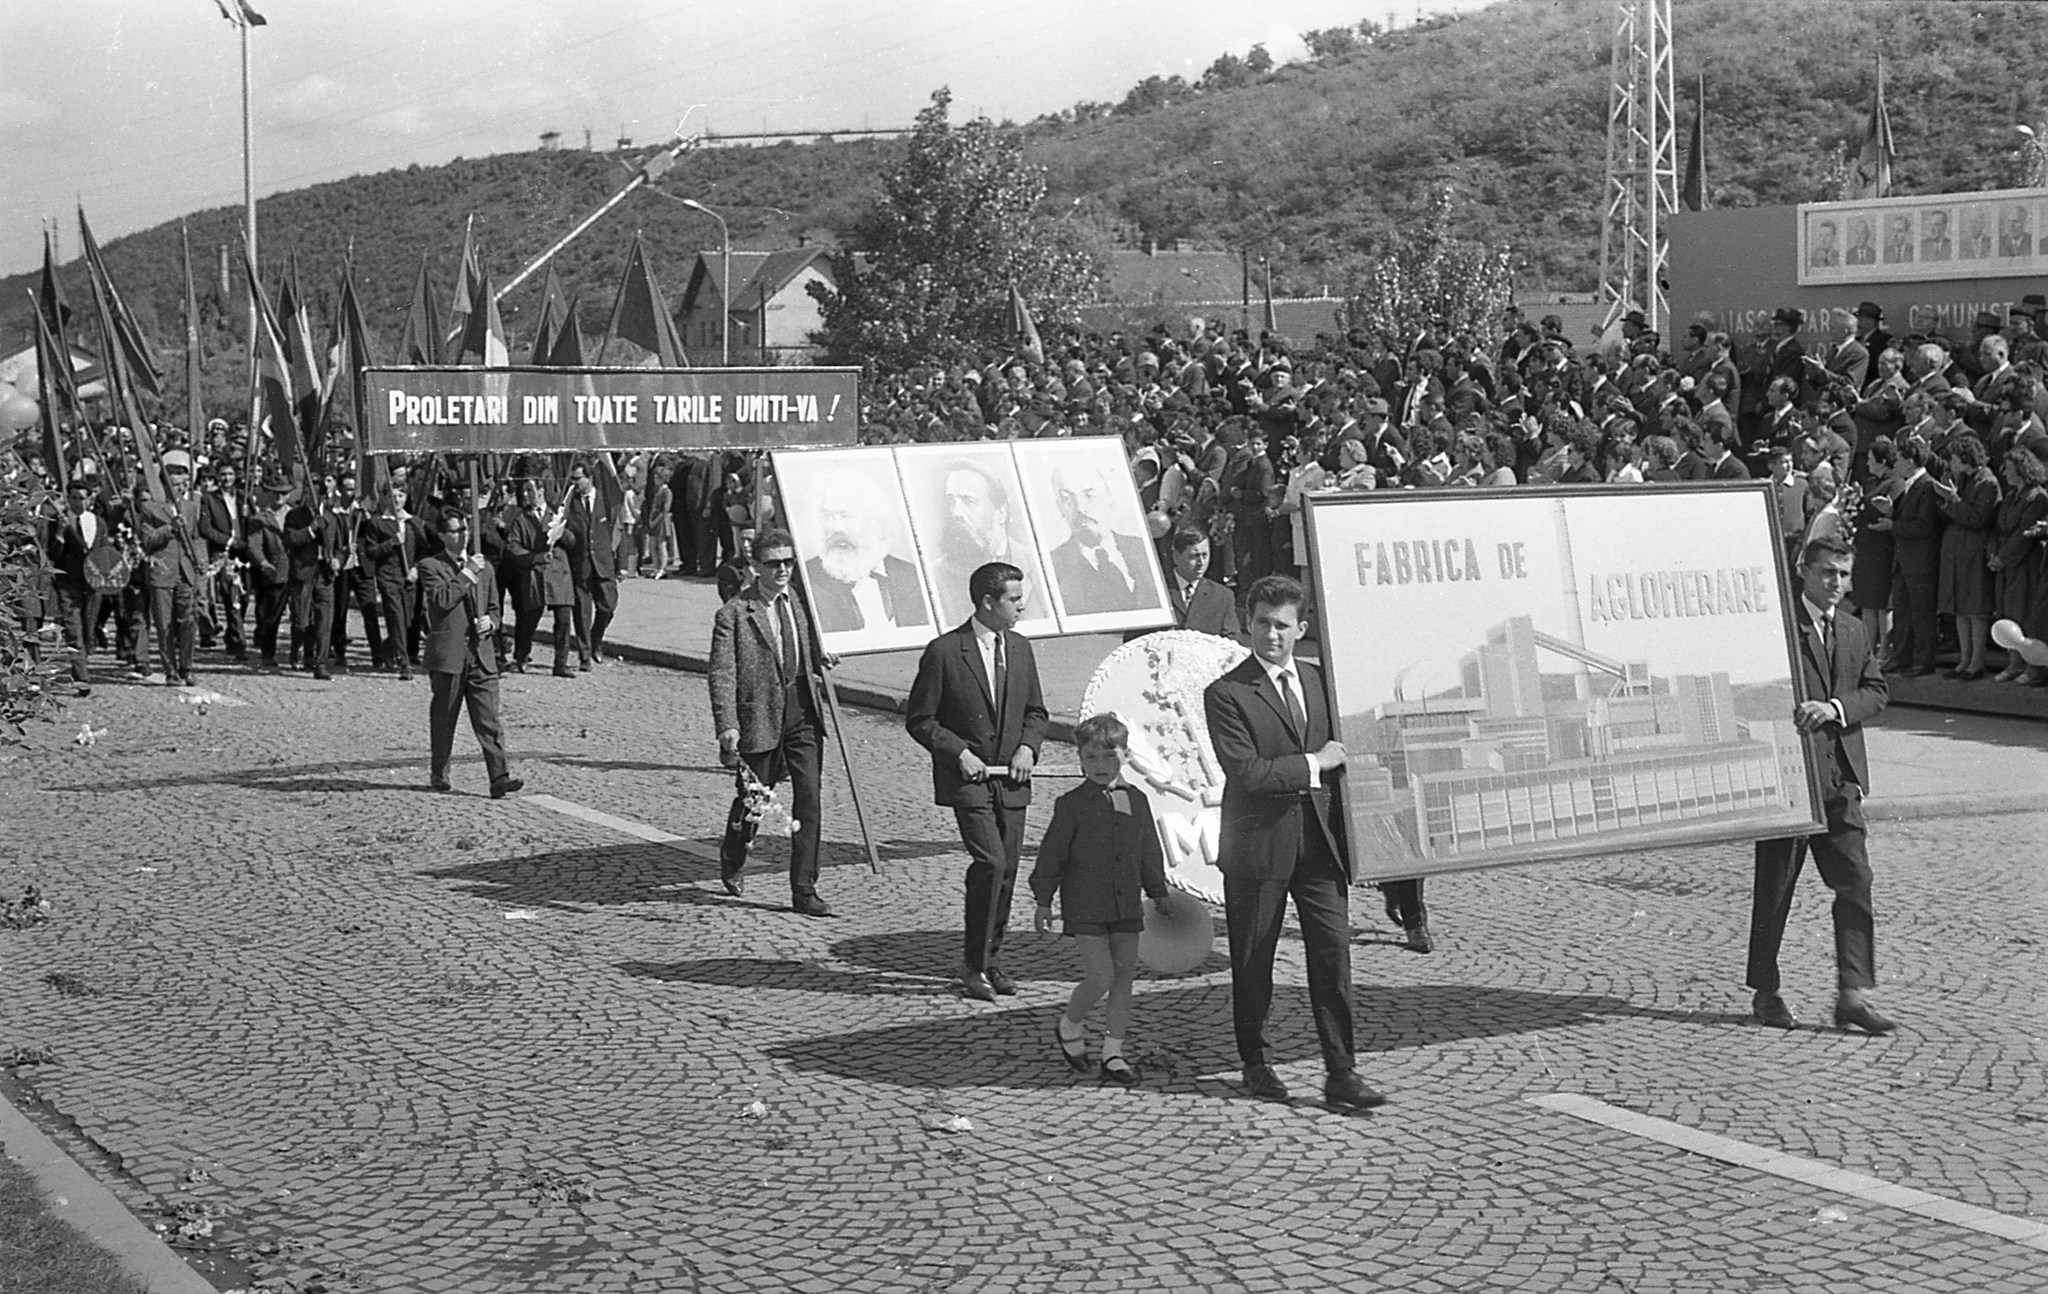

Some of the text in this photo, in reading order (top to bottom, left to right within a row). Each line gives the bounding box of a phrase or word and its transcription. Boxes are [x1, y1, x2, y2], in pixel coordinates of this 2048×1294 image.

[389, 390, 508, 425] PROLETARI
[523, 395, 558, 424] DIN
[574, 395, 638, 424] TOATE
[653, 395, 722, 424] TARILE
[735, 394, 819, 423] UNITI-VA
[1354, 538, 1527, 586] FABRICA DE
[1590, 566, 1768, 622] AGLOMERARE
